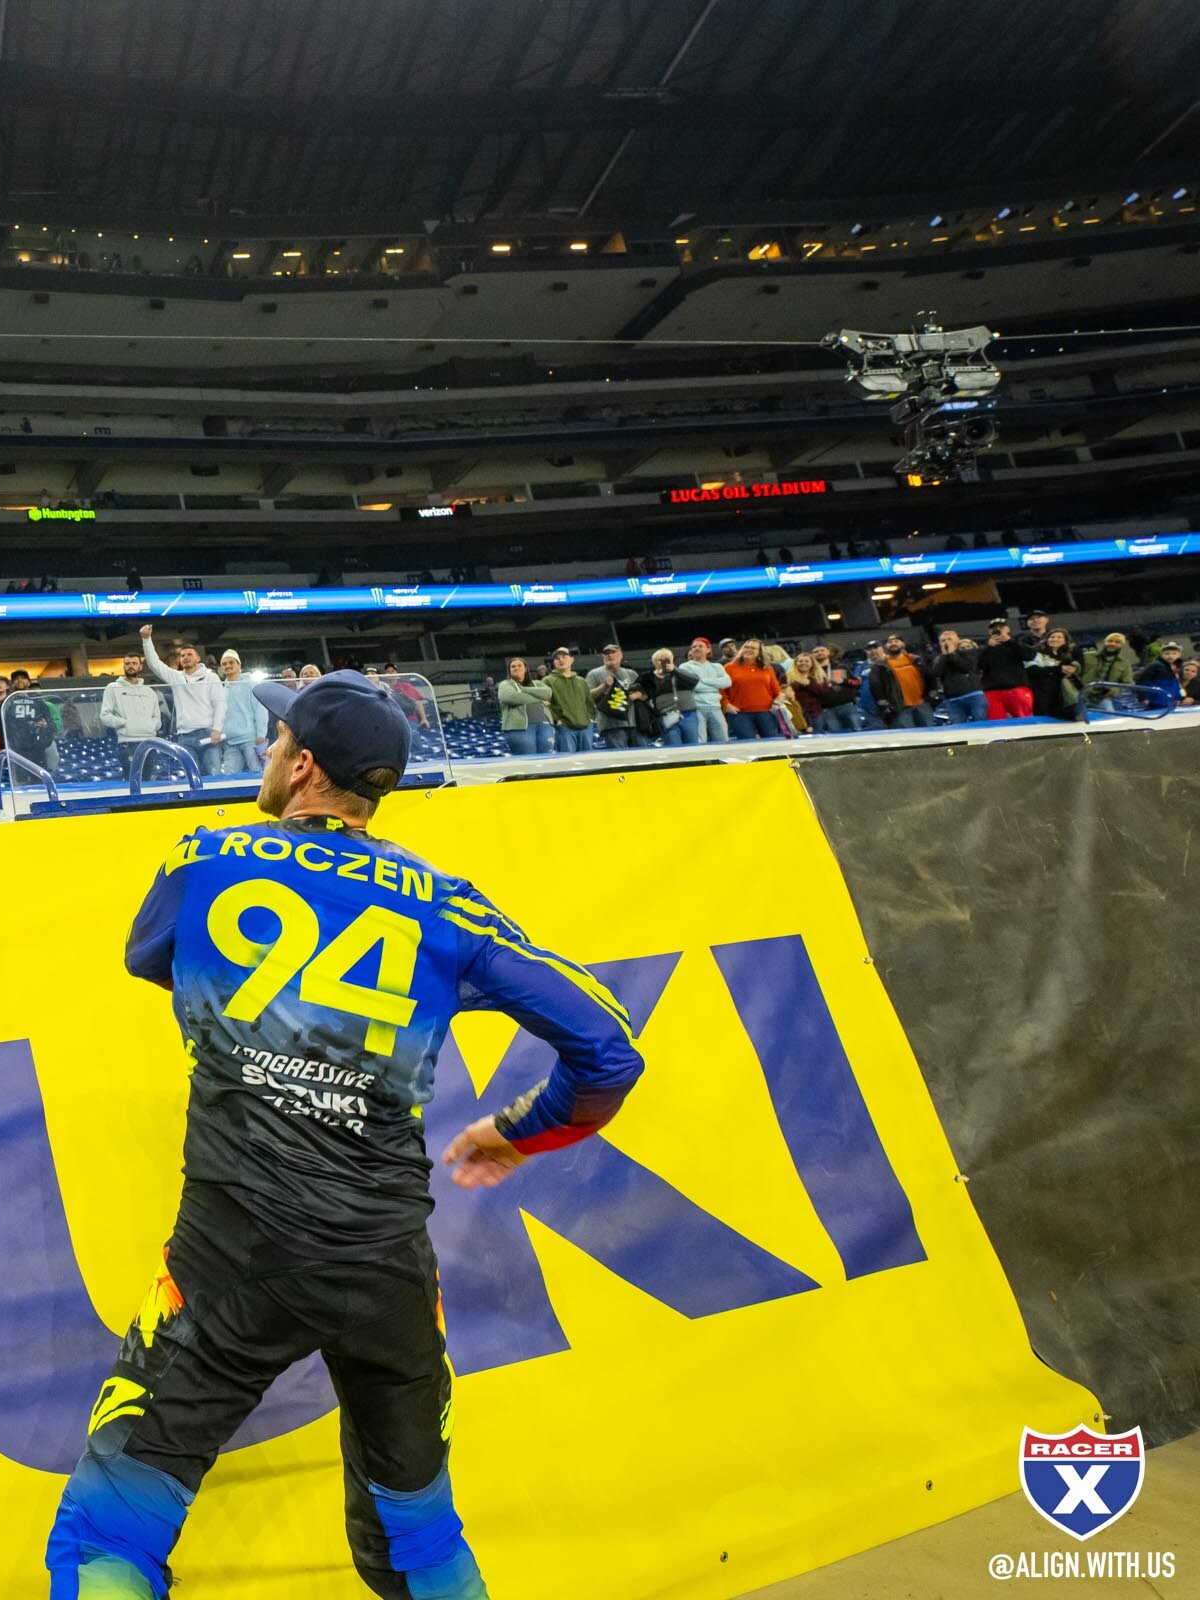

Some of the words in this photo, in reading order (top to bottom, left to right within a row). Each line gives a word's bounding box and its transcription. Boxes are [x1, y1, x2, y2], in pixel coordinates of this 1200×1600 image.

[670, 487, 720, 503] LUCAS
[722, 485, 750, 500] OIL
[751, 479, 826, 497] STADIUM
[41, 507, 96, 521] Huntington
[418, 506, 453, 518] verizon
[15, 704, 36, 719] 94
[218, 831, 434, 903] ROCZEN
[206, 878, 423, 1058] 94
